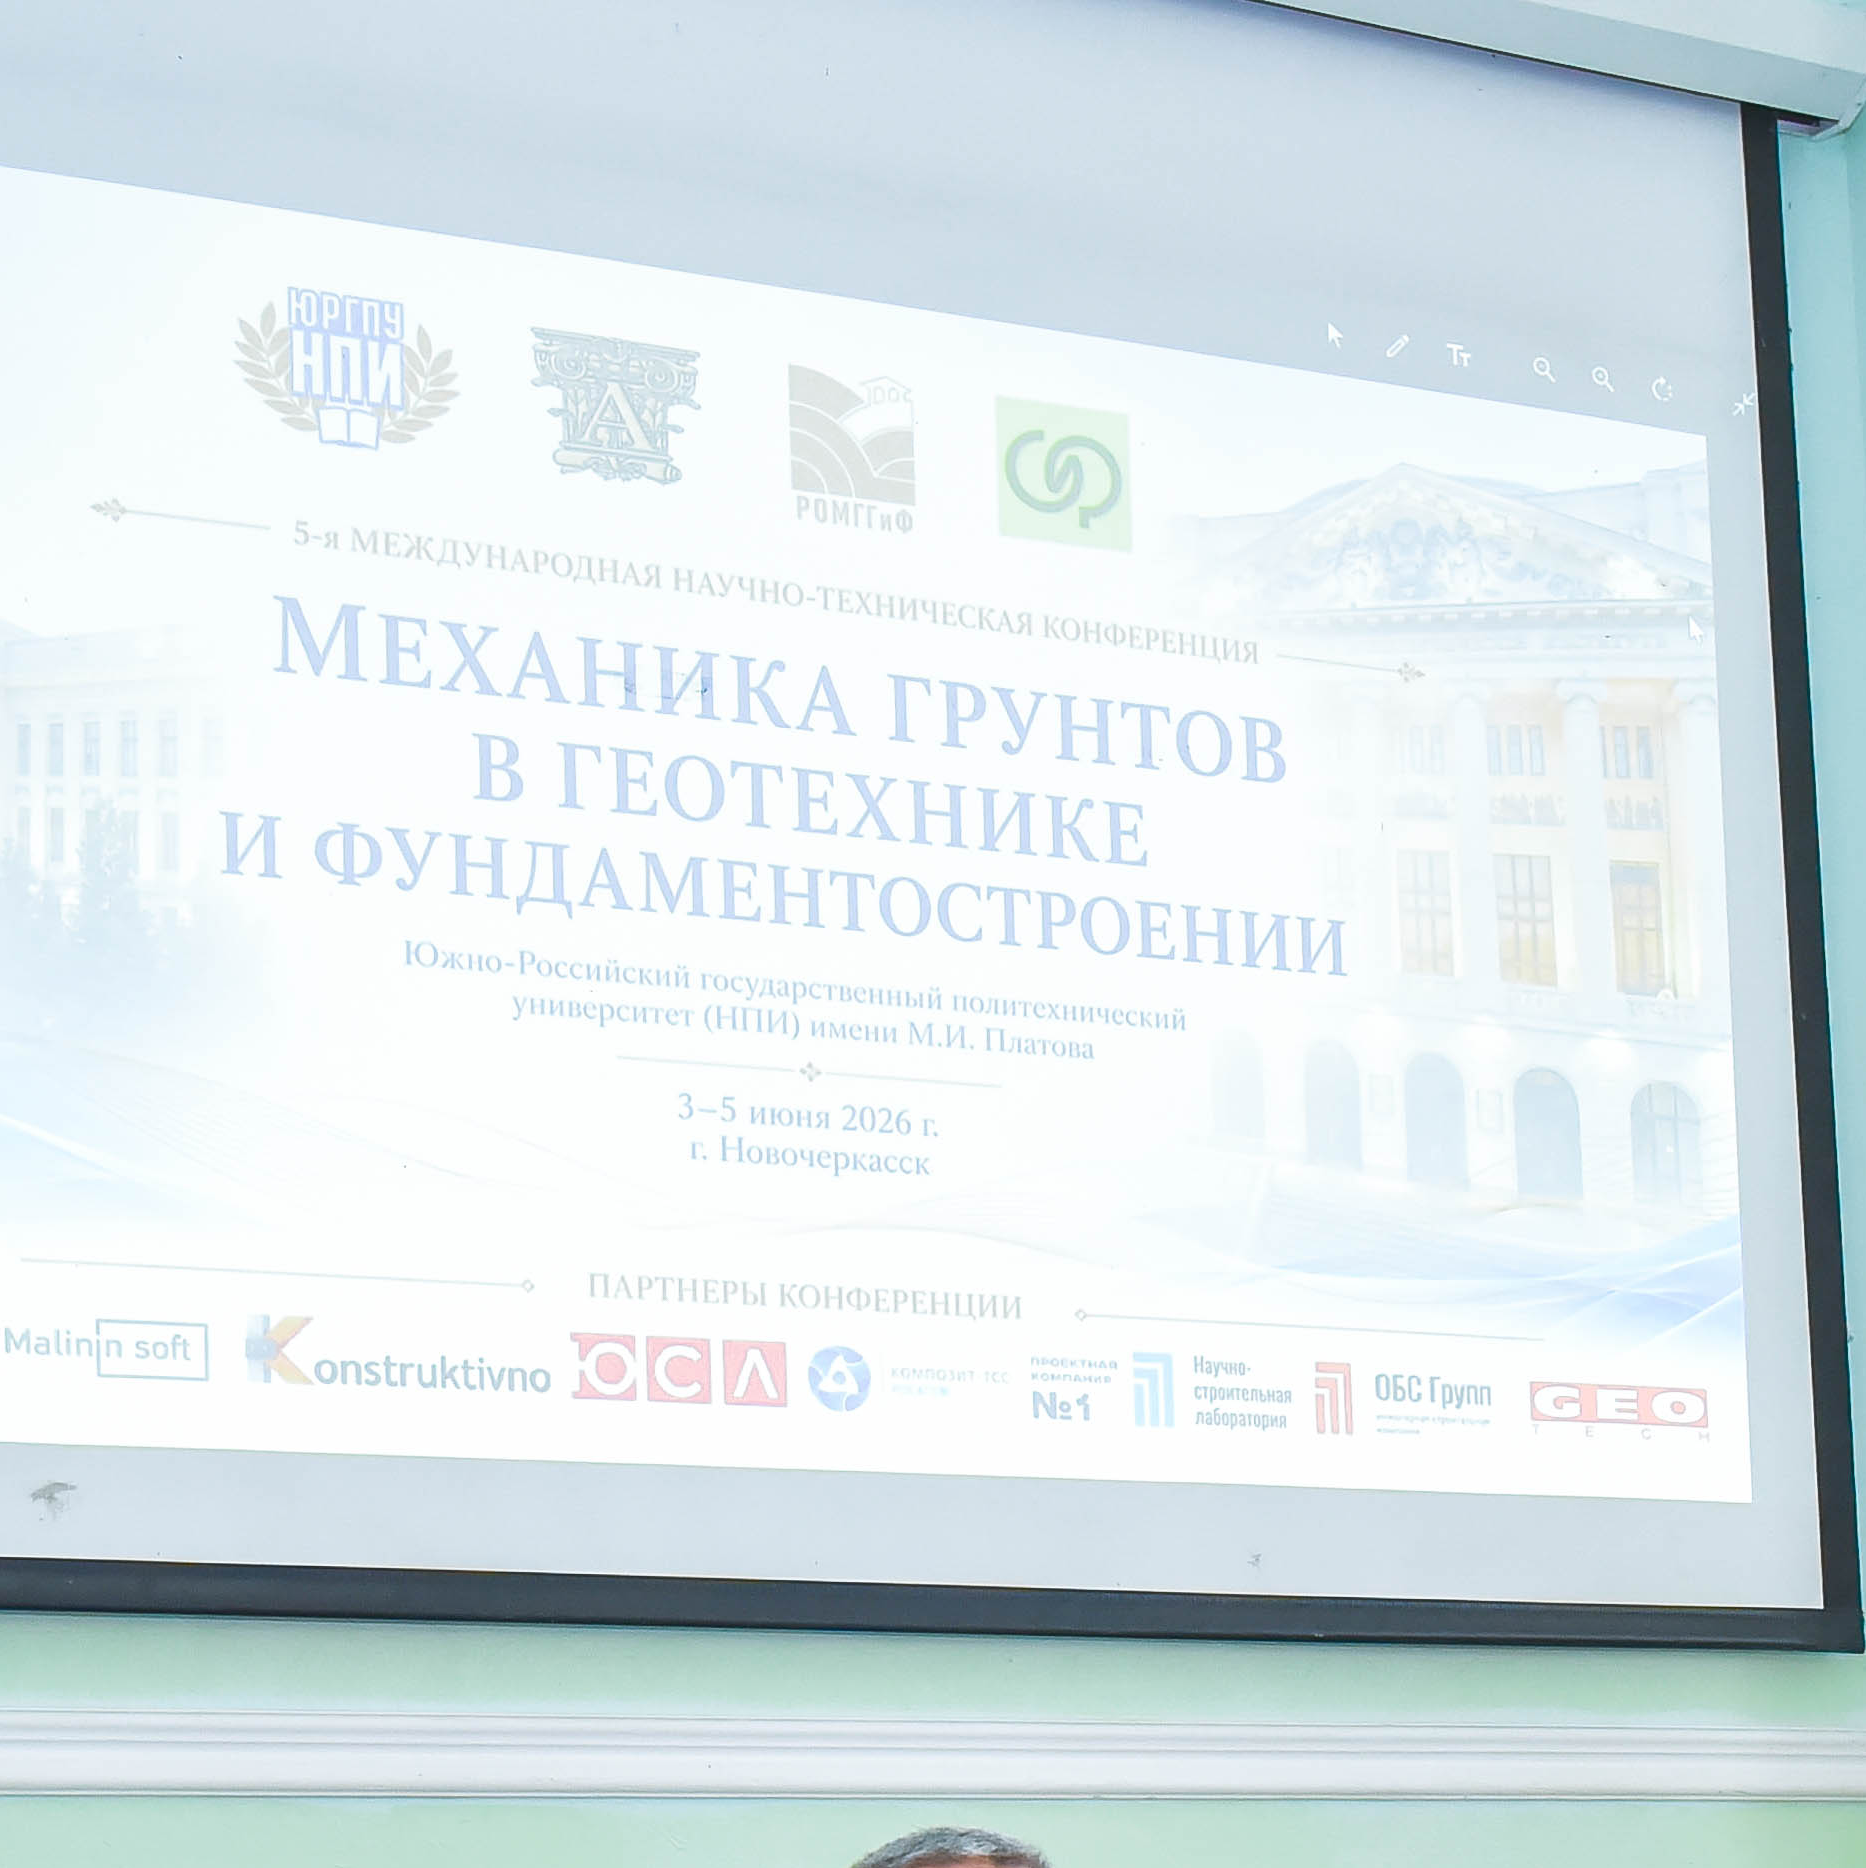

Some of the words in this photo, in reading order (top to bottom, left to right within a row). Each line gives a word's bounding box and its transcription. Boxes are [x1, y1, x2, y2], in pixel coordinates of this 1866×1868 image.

[288, 287, 404, 338] ЮРГПУ
[290, 328, 404, 411] НПИ
[796, 495, 914, 534] РОМГГиФ
[294, 520, 340, 550] 5-я
[350, 527, 663, 590] МЕЖДУНАРОДНАЯ
[673, 566, 1033, 637] НАУЧНО-ТЕХНИЧЕСКАЯ
[1043, 614, 1260, 665] КОНФЕРЕНЦИЯ
[273, 595, 857, 738] МЕХАНИКА
[886, 673, 1287, 784] ГРУНТОВ
[471, 733, 525, 803] В
[556, 742, 1149, 868] ГЕОТЕХНИКЕ
[219, 810, 283, 881] И
[313, 821, 1349, 977] ФУНДАМЕНТОСТРОЕНИИ
[403, 939, 690, 991] Южно-Российский
[700, 969, 943, 1011] государственный
[952, 991, 1187, 1032] политехнический
[512, 994, 696, 1028] университет
[703, 1003, 801, 1041] (НПИ)
[810, 1015, 898, 1045] имени
[908, 1020, 975, 1051] М.И.
[984, 1026, 1096, 1061] Платова
[749, 1105, 831, 1130] июня
[841, 1104, 912, 1136] 2026
[922, 1117, 939, 1138] г.
[690, 1140, 708, 1161] г.
[720, 1135, 931, 1177] Новочеркасск
[588, 1272, 768, 1308] ПАРТНЕРЫ
[778, 1282, 1023, 1321] КОНФЕРЕНЦИИ
[135, 1333, 191, 1362] soft
[245, 1314, 552, 1394] Konstruktivno
[1031, 1355, 1119, 1371] ПРОЕКТНАЯ
[1193, 1355, 1252, 1378] Научно-
[1031, 1371, 1113, 1384] КОМПАНИЯ
[1193, 1384, 1293, 1405] строительная
[1375, 1373, 1423, 1403] ОБС
[1428, 1375, 1492, 1410] Групп
[1195, 1406, 1288, 1432] лаборатория
[1533, 1383, 1709, 1426] GEO
